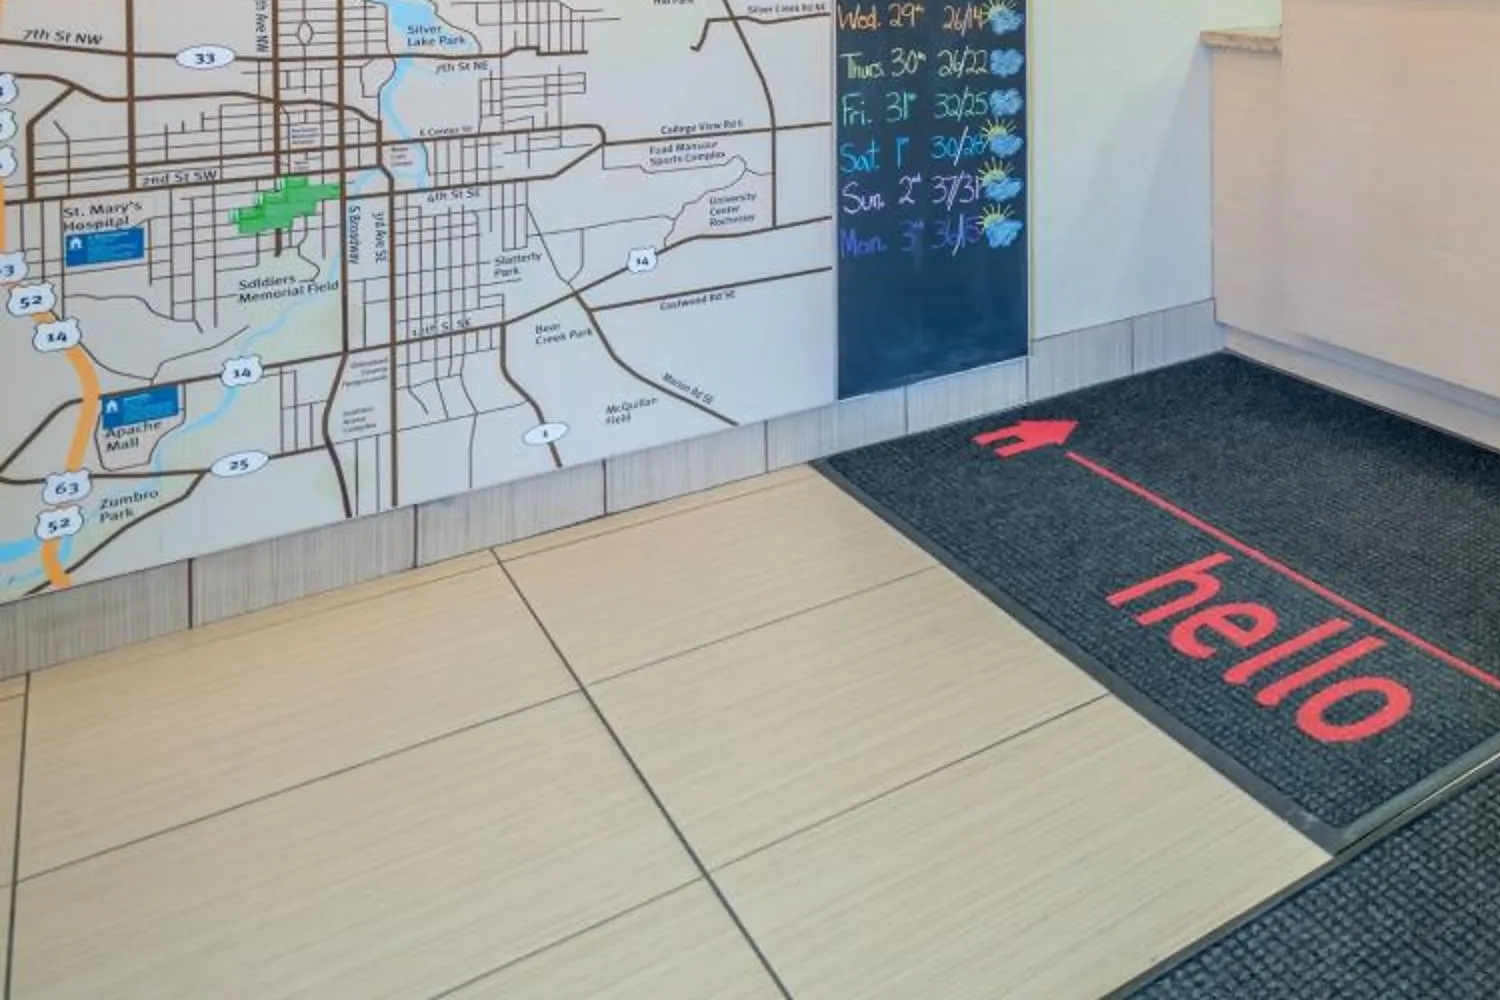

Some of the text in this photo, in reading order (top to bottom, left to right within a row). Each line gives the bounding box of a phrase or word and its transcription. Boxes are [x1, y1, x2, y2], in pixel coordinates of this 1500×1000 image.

[407, 24, 442, 35] Silver
[22, 29, 103, 46] 7th St NW
[407, 34, 466, 48] Lake Park
[194, 52, 215, 65] 33
[473, 61, 489, 71] NE
[142, 169, 220, 186] 2nd St SW
[63, 200, 143, 218] St. Mary's
[63, 215, 130, 231] Hospital
[0, 263, 15, 278] 3
[239, 275, 296, 290] Soldiers
[239, 280, 340, 302] Memorial Field
[20, 294, 43, 308] 52
[47, 331, 68, 343] 14
[233, 367, 252, 378] 14
[104, 421, 163, 439] Apache
[106, 437, 140, 452] Mall
[229, 459, 249, 471] 25
[55, 482, 79, 495] 63
[100, 489, 160, 510] Zumbro
[100, 507, 135, 523] Park
[47, 518, 71, 533] 52
[1104, 551, 1415, 744] hello
